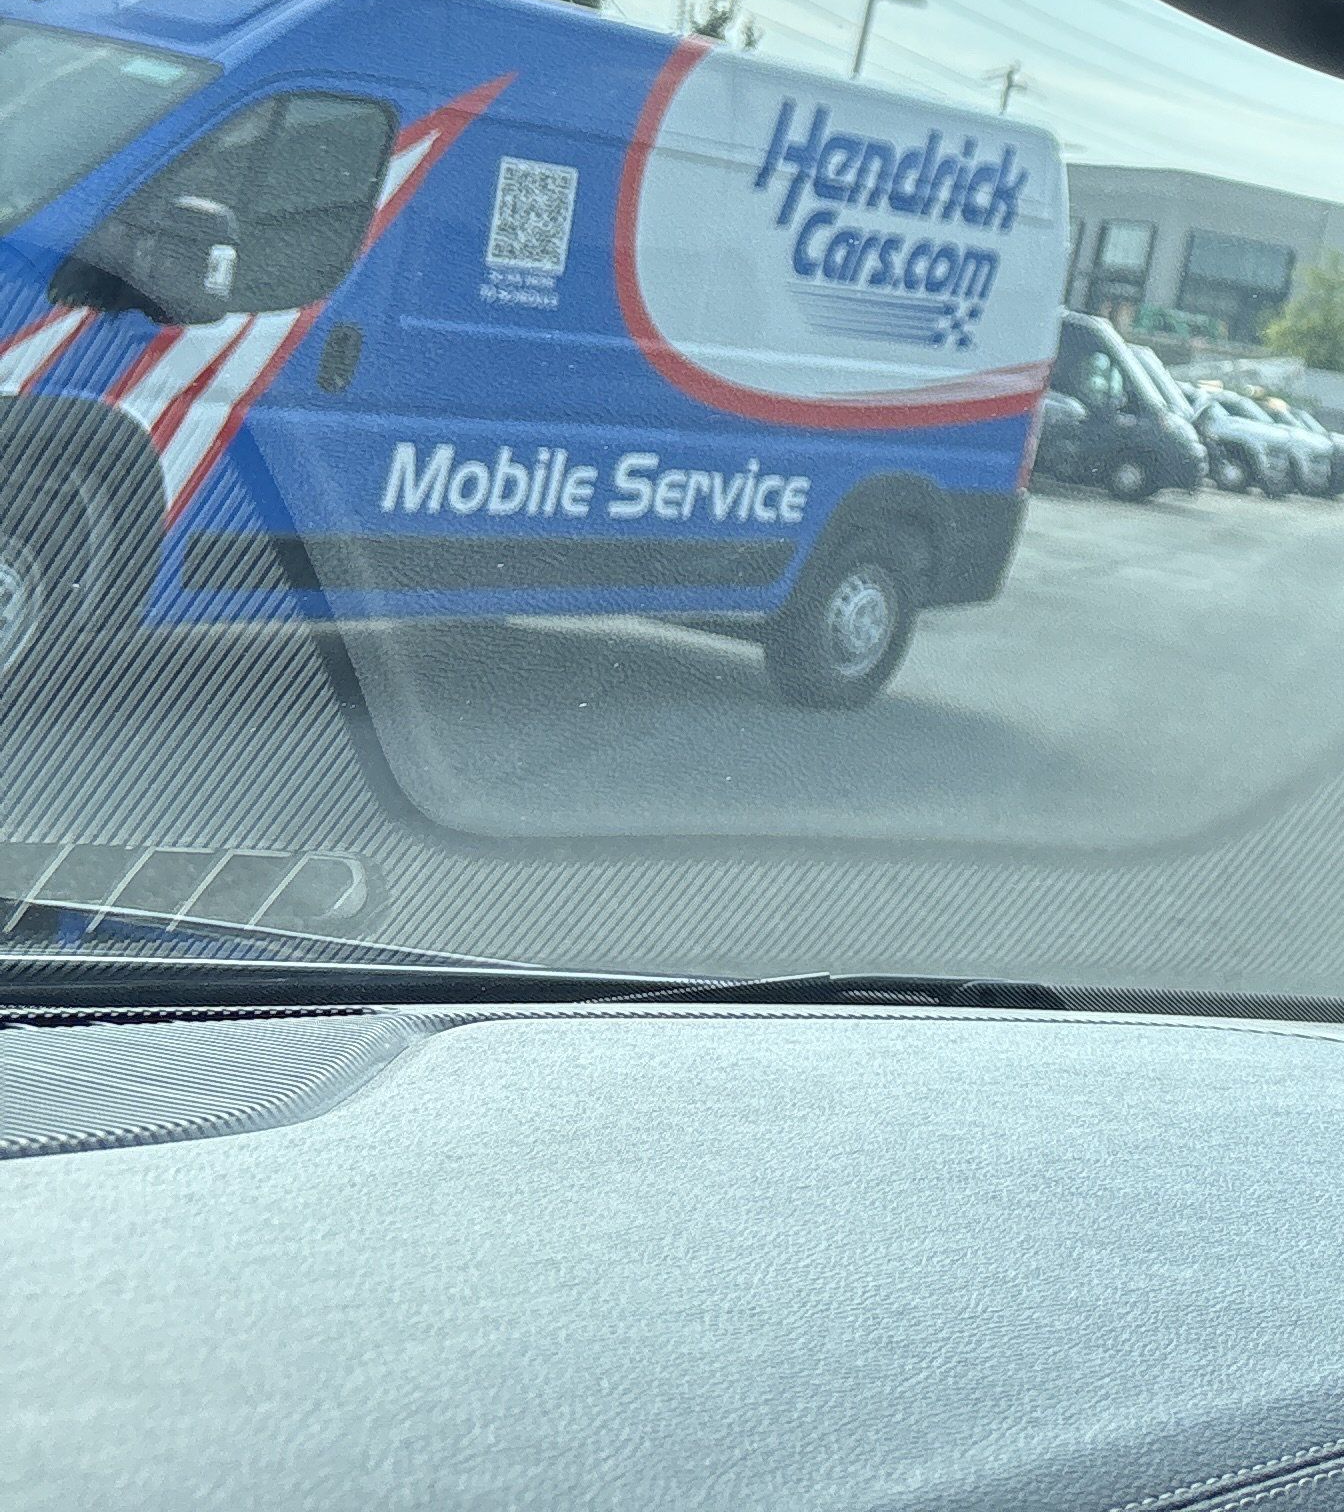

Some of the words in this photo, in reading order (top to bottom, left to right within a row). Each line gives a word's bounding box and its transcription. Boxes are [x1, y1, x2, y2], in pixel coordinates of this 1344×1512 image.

[754, 96, 1029, 232] Hendrick
[793, 208, 1000, 301] Cars.com
[380, 441, 598, 518] Mobile
[607, 451, 811, 524] Service
